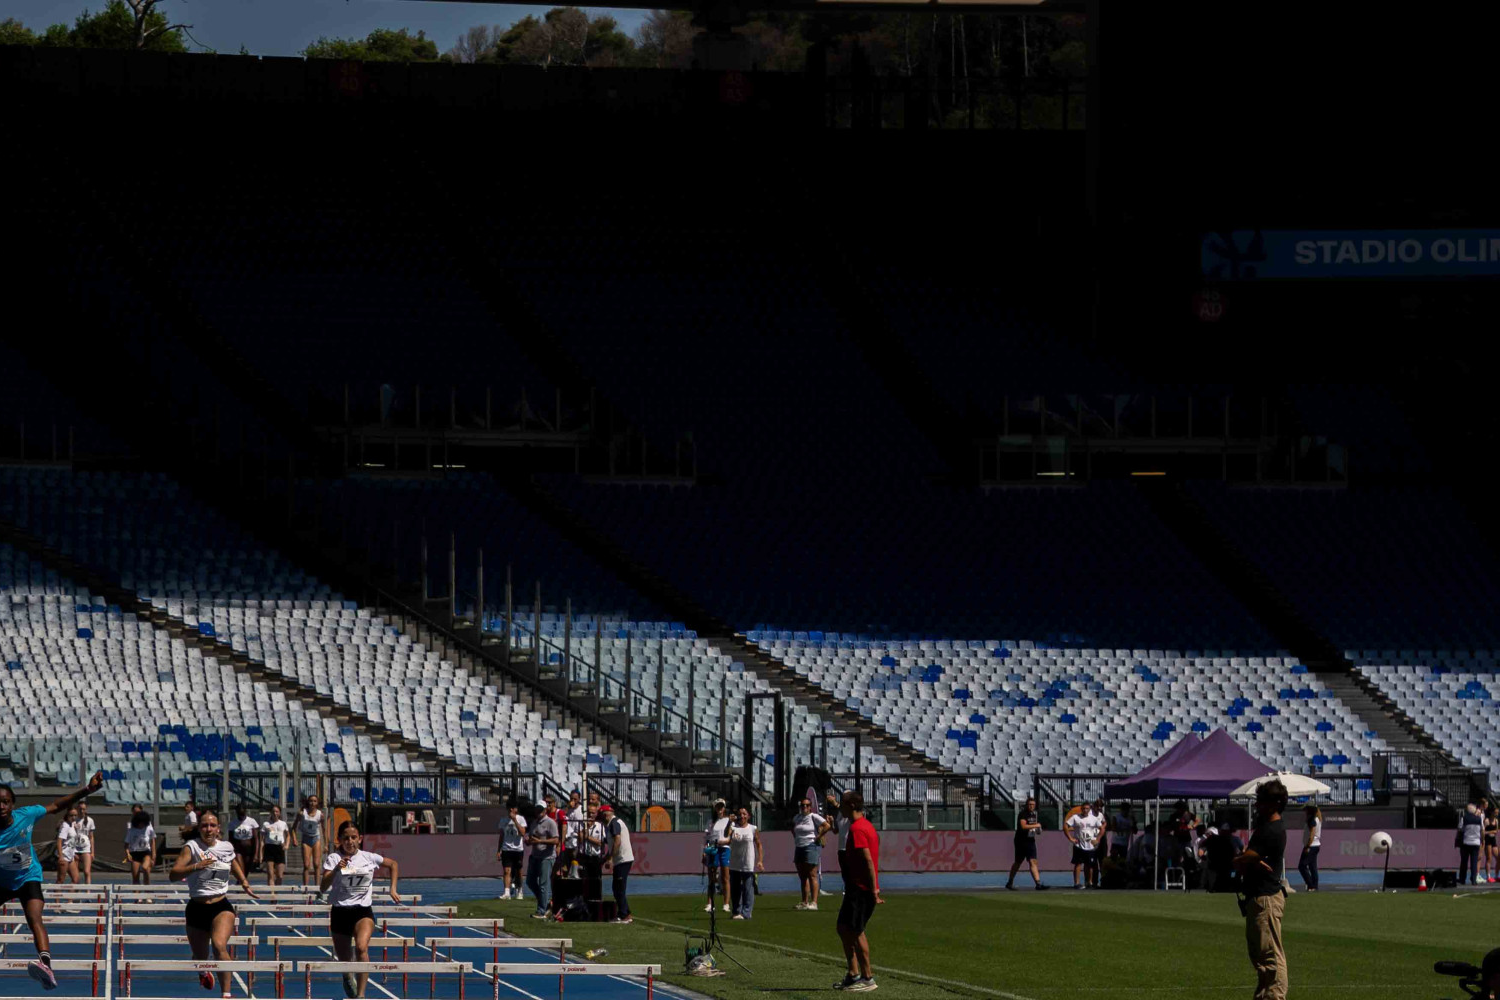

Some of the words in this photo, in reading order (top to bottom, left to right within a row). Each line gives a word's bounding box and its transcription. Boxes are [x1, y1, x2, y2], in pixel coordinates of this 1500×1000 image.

[1294, 238, 1423, 264] STADIO
[11, 853, 22, 863] 5
[347, 875, 364, 887] 17
